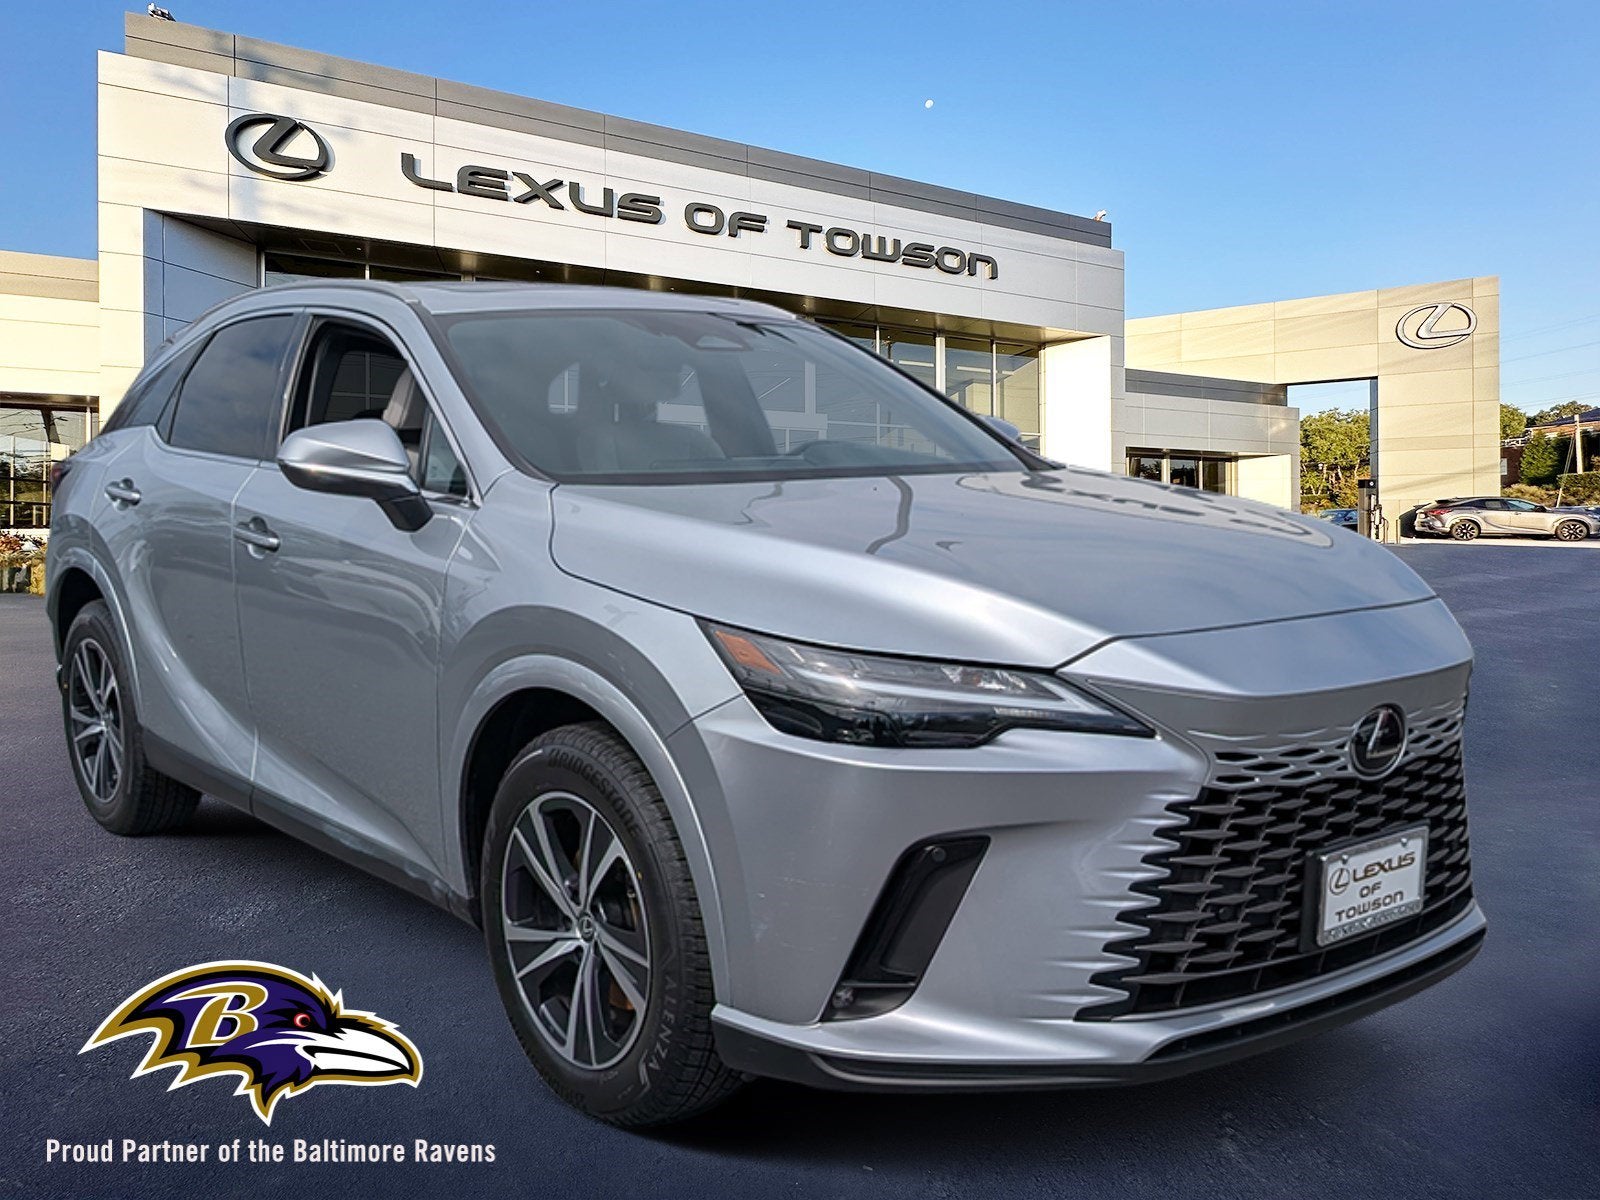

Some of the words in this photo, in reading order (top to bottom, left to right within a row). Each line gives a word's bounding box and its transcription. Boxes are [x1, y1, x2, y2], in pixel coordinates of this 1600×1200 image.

[401, 152, 664, 225] LEXUS
[684, 202, 768, 238] OF
[786, 219, 999, 280] TOWSON
[547, 748, 642, 839] BRIDGESTONE
[1353, 851, 1416, 882] LEXUS
[1358, 880, 1382, 898] OF
[1334, 890, 1404, 922] TOWSON
[648, 975, 677, 1071] ALENZA
